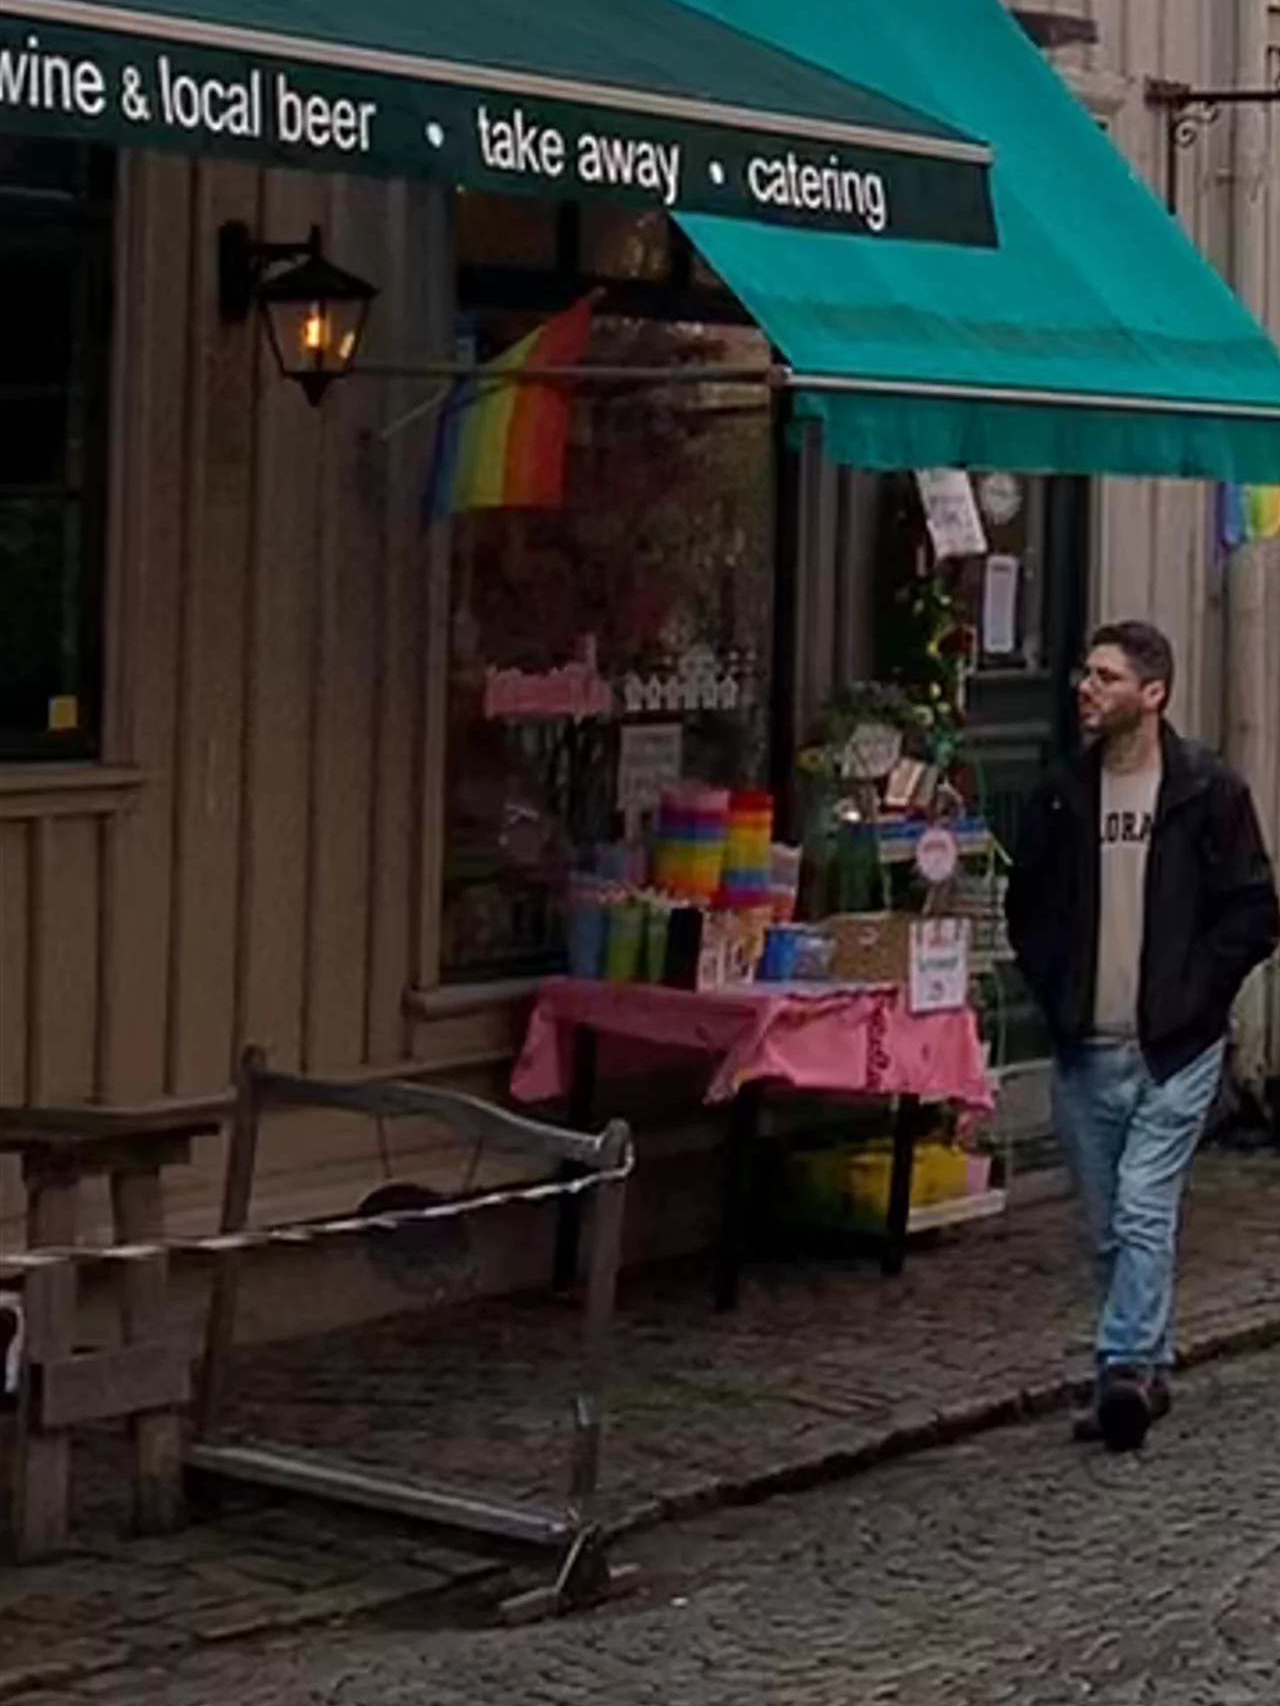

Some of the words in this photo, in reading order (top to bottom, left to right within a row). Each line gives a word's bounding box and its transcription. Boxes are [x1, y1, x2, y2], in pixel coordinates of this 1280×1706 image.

[121, 65, 150, 122] &
[157, 54, 262, 138] local
[276, 71, 377, 152] beer
[477, 104, 566, 177] take
[577, 132, 680, 206] away
[747, 149, 888, 232] catering
